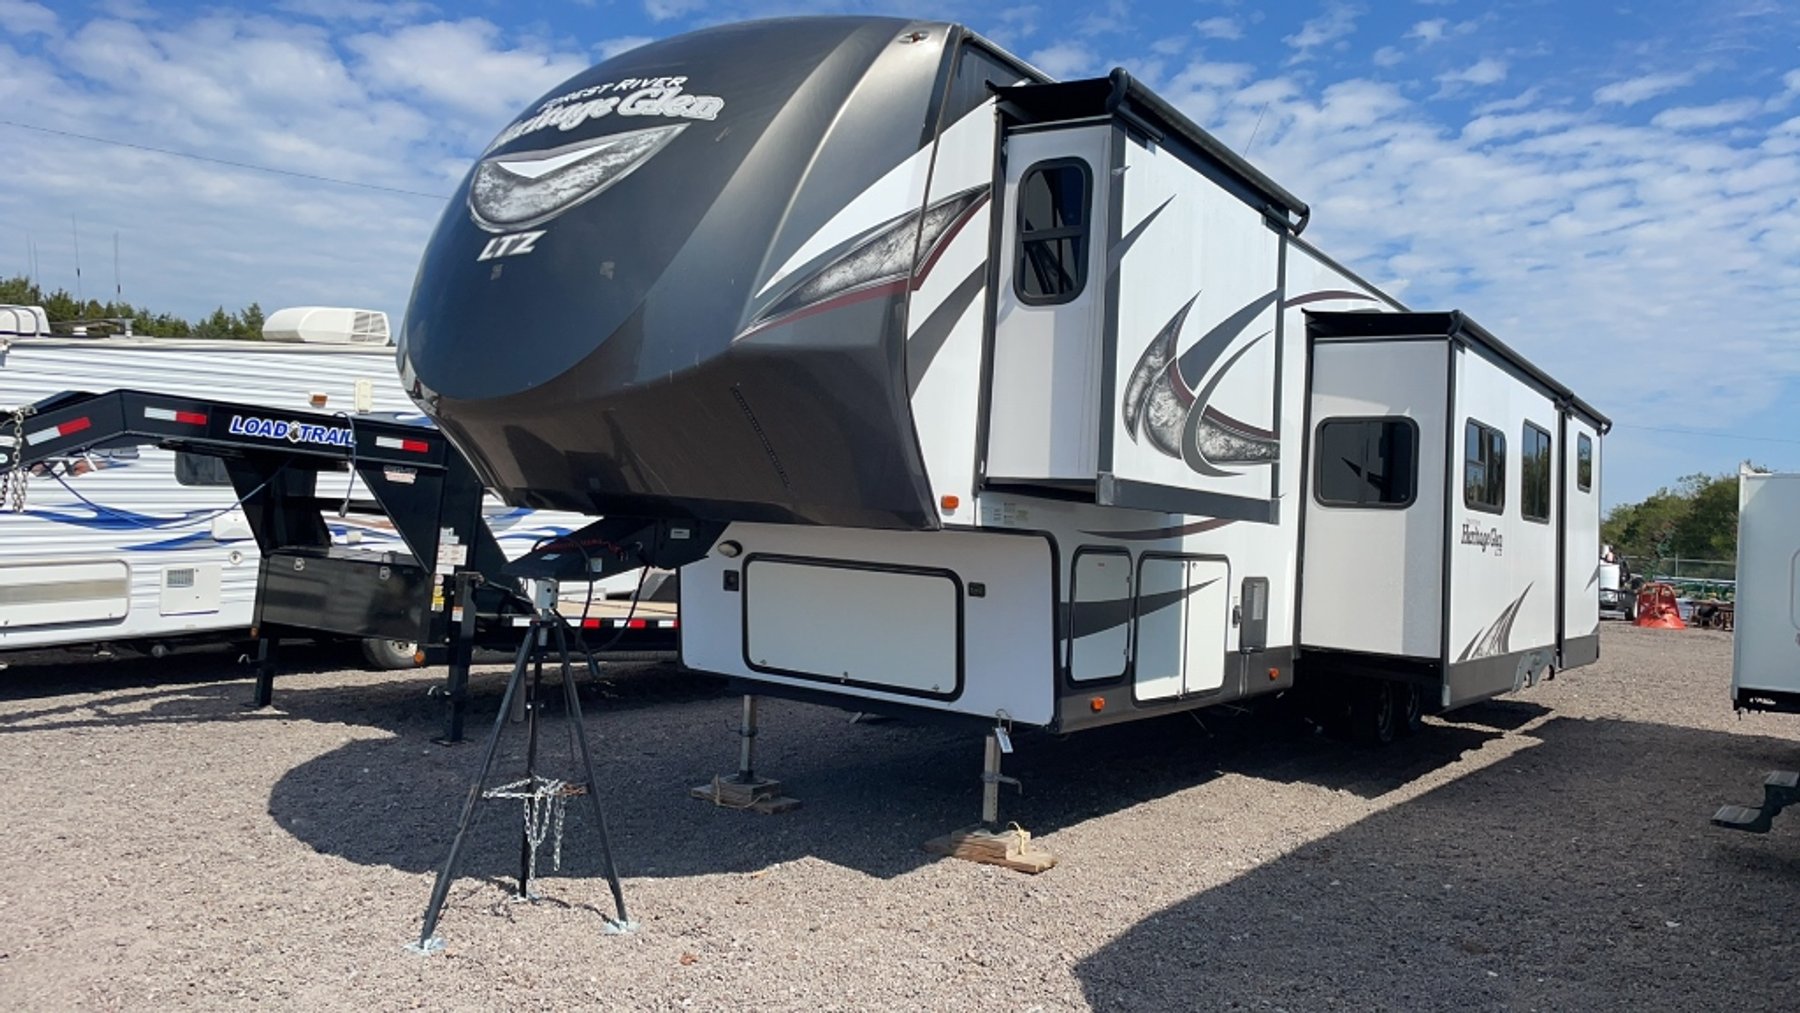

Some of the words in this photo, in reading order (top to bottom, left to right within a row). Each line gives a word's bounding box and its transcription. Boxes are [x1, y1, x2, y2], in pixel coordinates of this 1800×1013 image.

[613, 76, 688, 91] RIVER
[484, 97, 620, 155] itage
[617, 87, 725, 120] Glen
[477, 230, 547, 261] LTZ
[229, 415, 289, 438] LOAD
[299, 423, 355, 447] TRAIL
